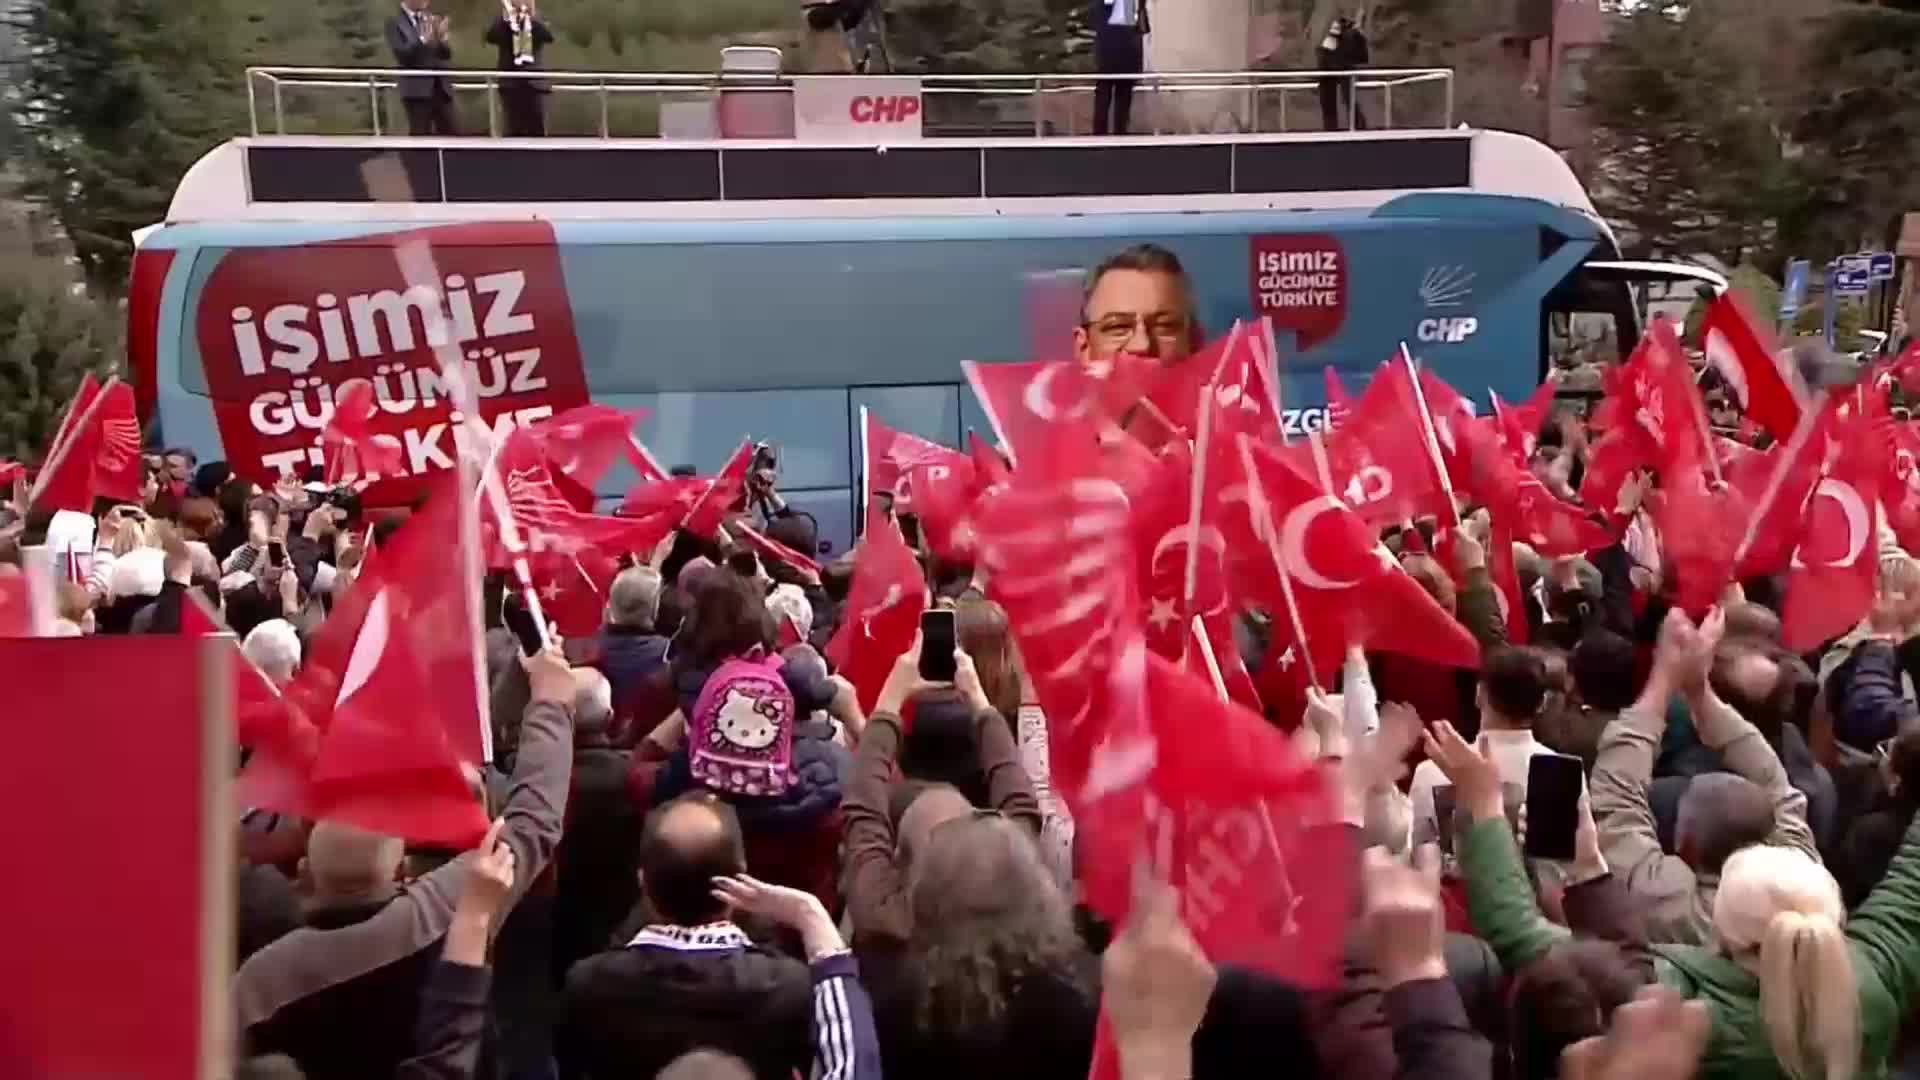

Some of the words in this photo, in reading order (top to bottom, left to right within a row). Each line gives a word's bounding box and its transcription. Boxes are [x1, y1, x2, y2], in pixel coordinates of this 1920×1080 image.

[850, 96, 919, 122] CHP
[1258, 273, 1337, 289] GÜCÜMÜZ
[1260, 290, 1337, 308] TÜRKİYE
[1417, 317, 1478, 342] CHP
